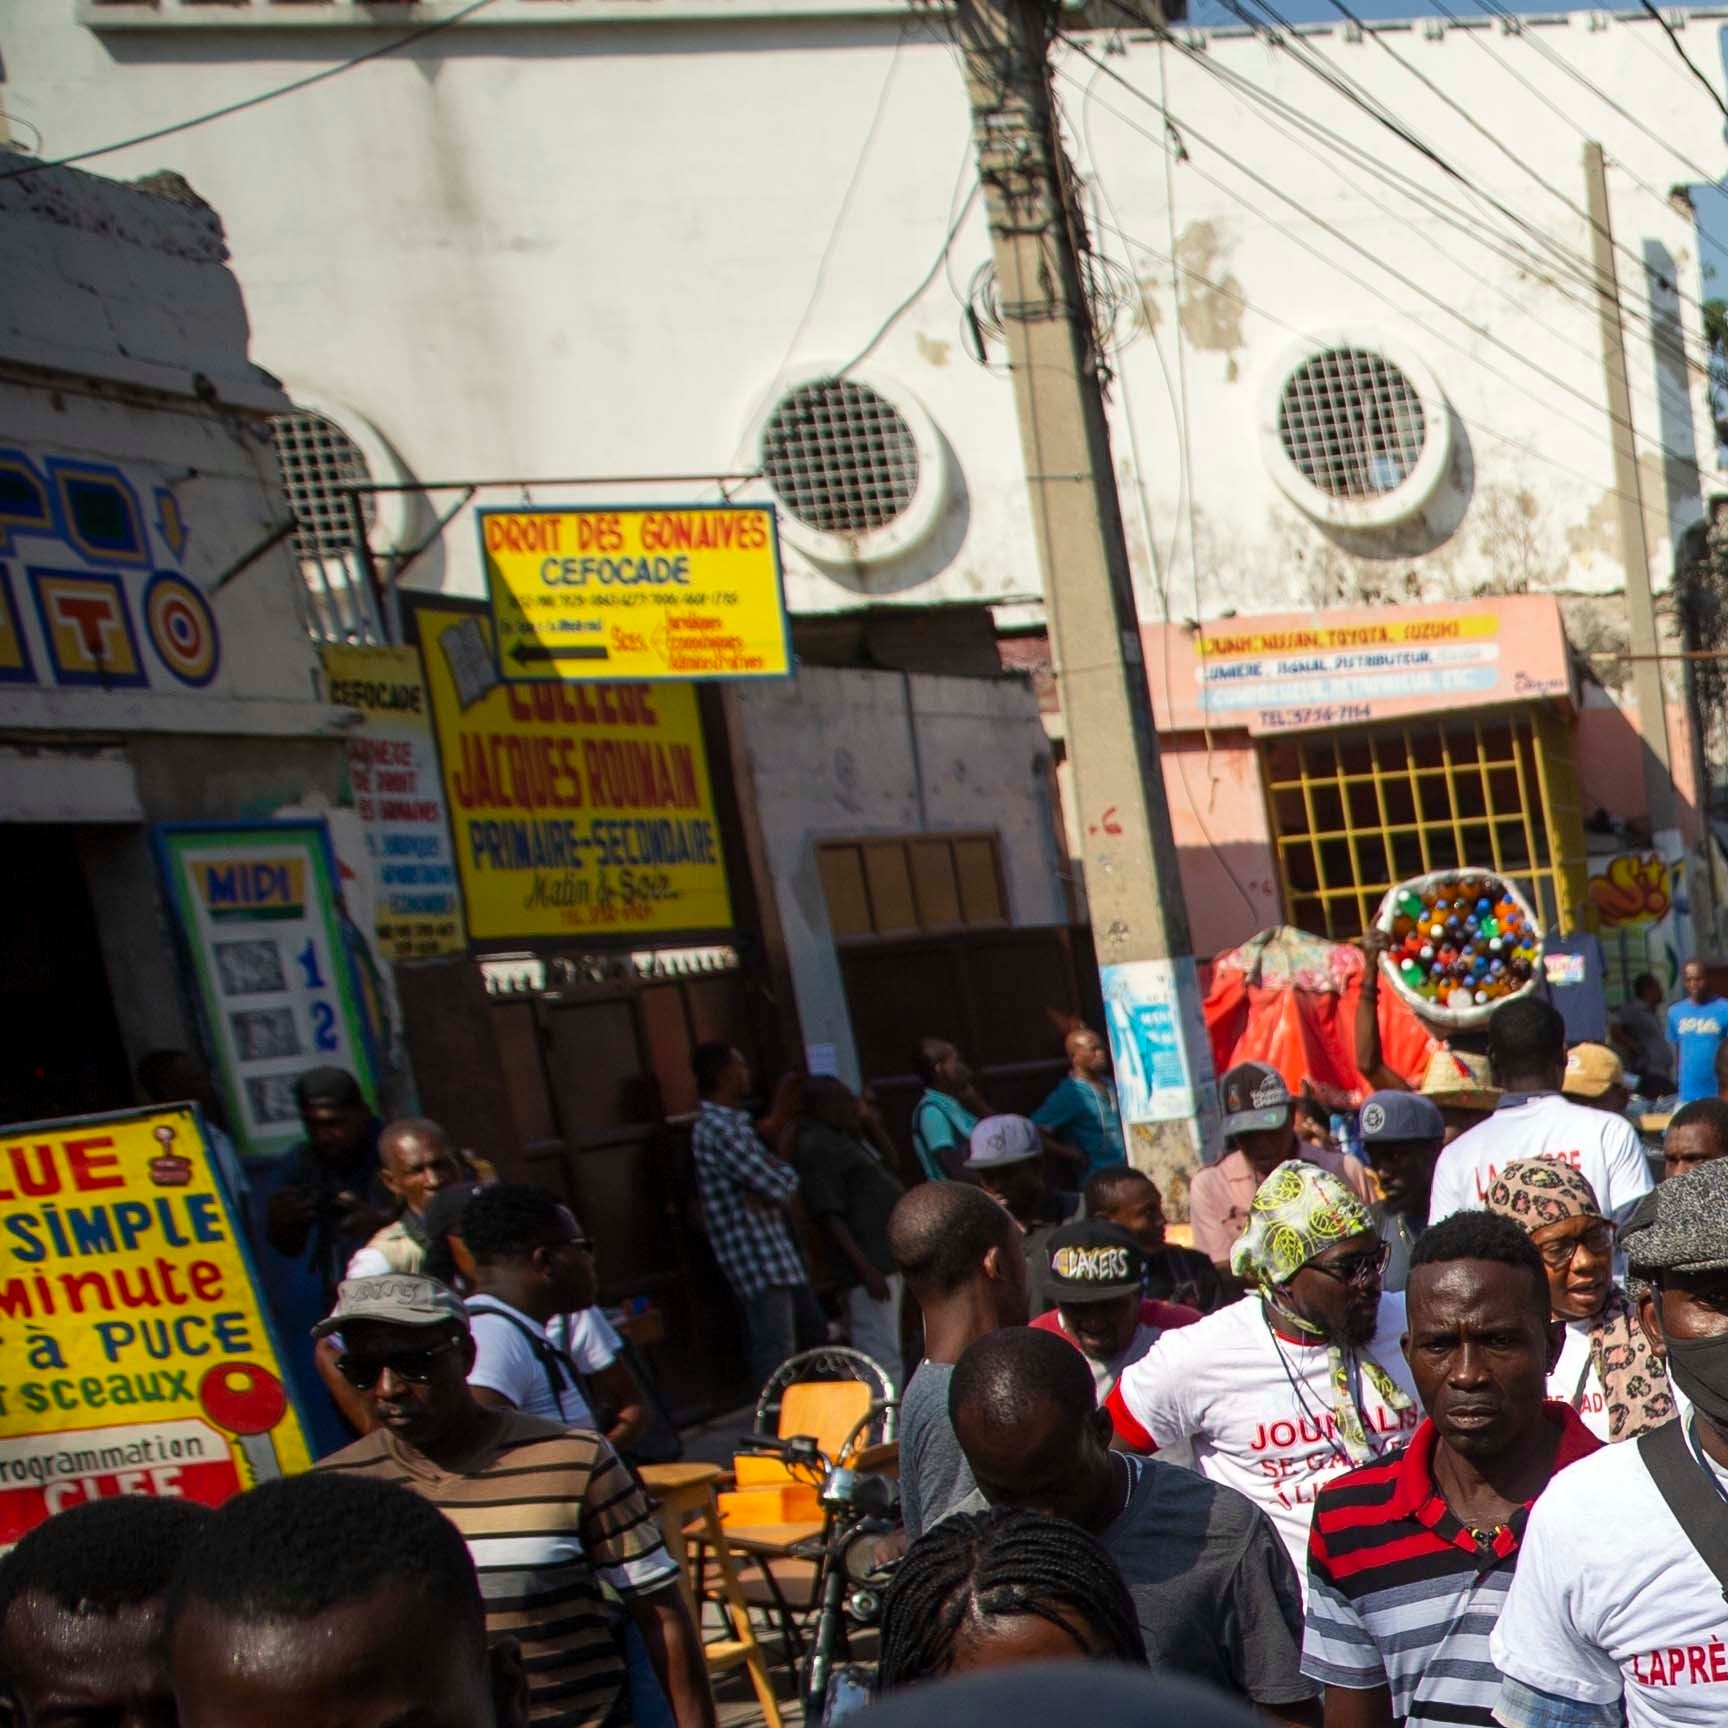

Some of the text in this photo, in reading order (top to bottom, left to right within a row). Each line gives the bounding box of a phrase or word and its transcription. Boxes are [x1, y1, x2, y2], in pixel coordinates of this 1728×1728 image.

[487, 515, 562, 552] DROIT
[577, 513, 624, 550] DES
[540, 555, 691, 586] CEFOCADE
[452, 731, 583, 811] JACQUES
[207, 863, 291, 905] MIDI
[297, 937, 325, 990] 1
[312, 1002, 338, 1053] 2
[0, 1136, 125, 1198] UE
[1068, 1247, 1129, 1281] LAKERS
[25, 1311, 254, 1370] à PUCE
[19, 1368, 197, 1415] sceaux
